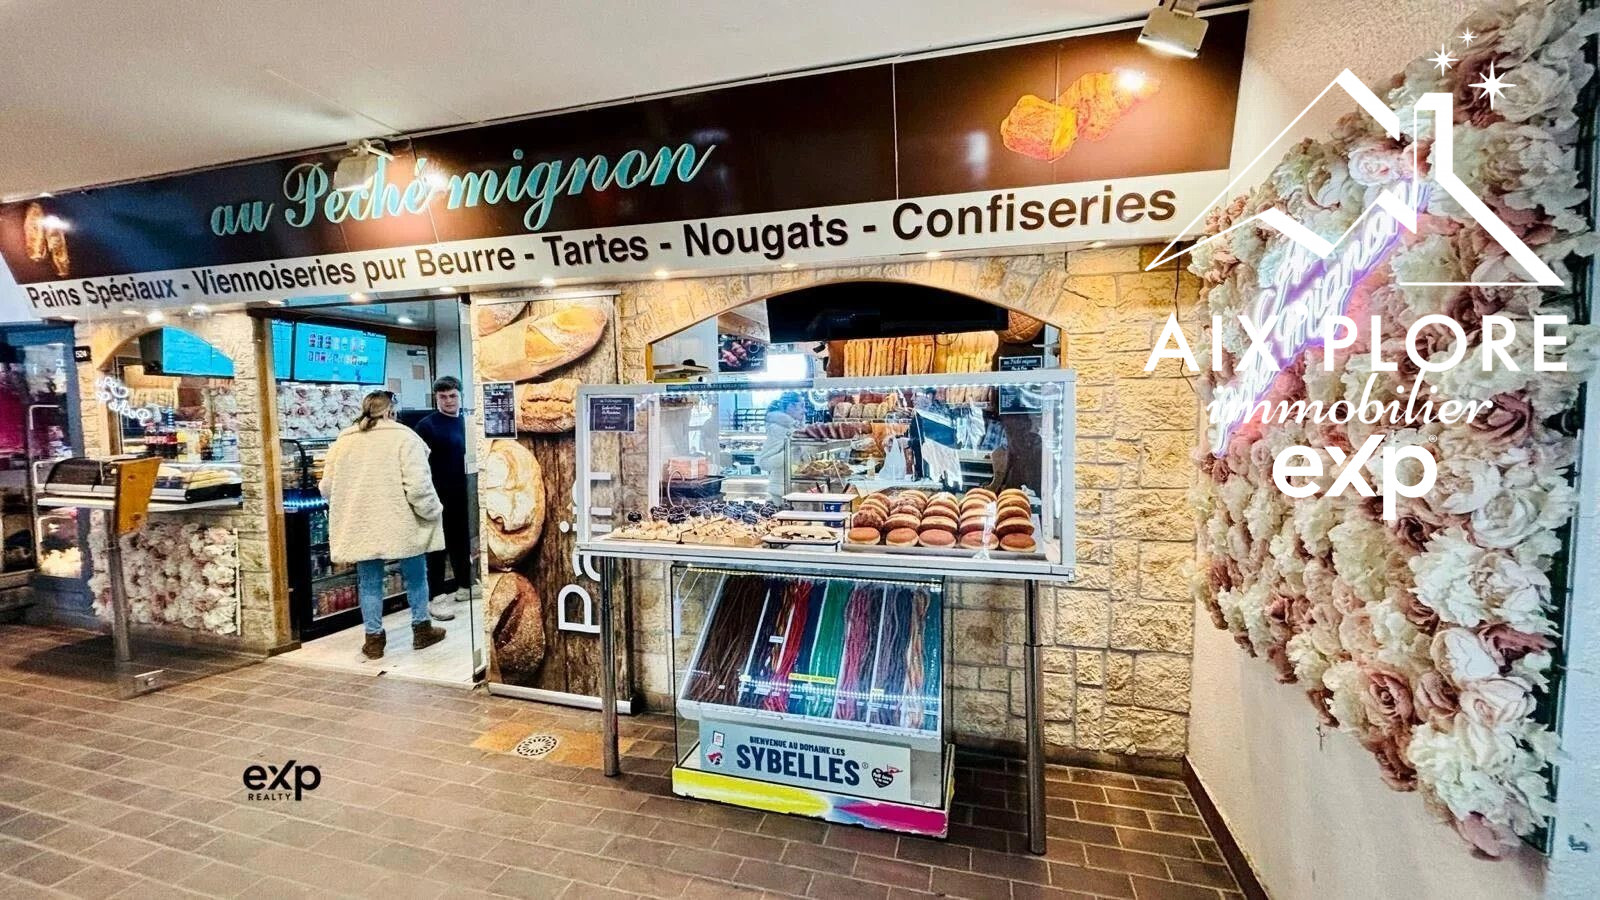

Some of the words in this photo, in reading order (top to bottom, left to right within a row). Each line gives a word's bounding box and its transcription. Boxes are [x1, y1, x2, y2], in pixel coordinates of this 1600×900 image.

[211, 201, 275, 236] au
[447, 143, 717, 231] mignon
[26, 284, 79, 309] Pains
[82, 277, 178, 309] Spéciaux
[191, 258, 357, 296] Viennoiseries
[362, 255, 408, 290] pur
[415, 246, 516, 277] Beurre
[542, 233, 649, 267] Tartes
[683, 214, 849, 260] Nougats
[892, 184, 1177, 240] Confiseries
[736, 744, 860, 787] SYBELLES
[750, 736, 787, 748] BIENVENUE
[789, 741, 798, 750] AU
[800, 743, 831, 754] DOMAINE
[832, 747, 845, 756] LES
